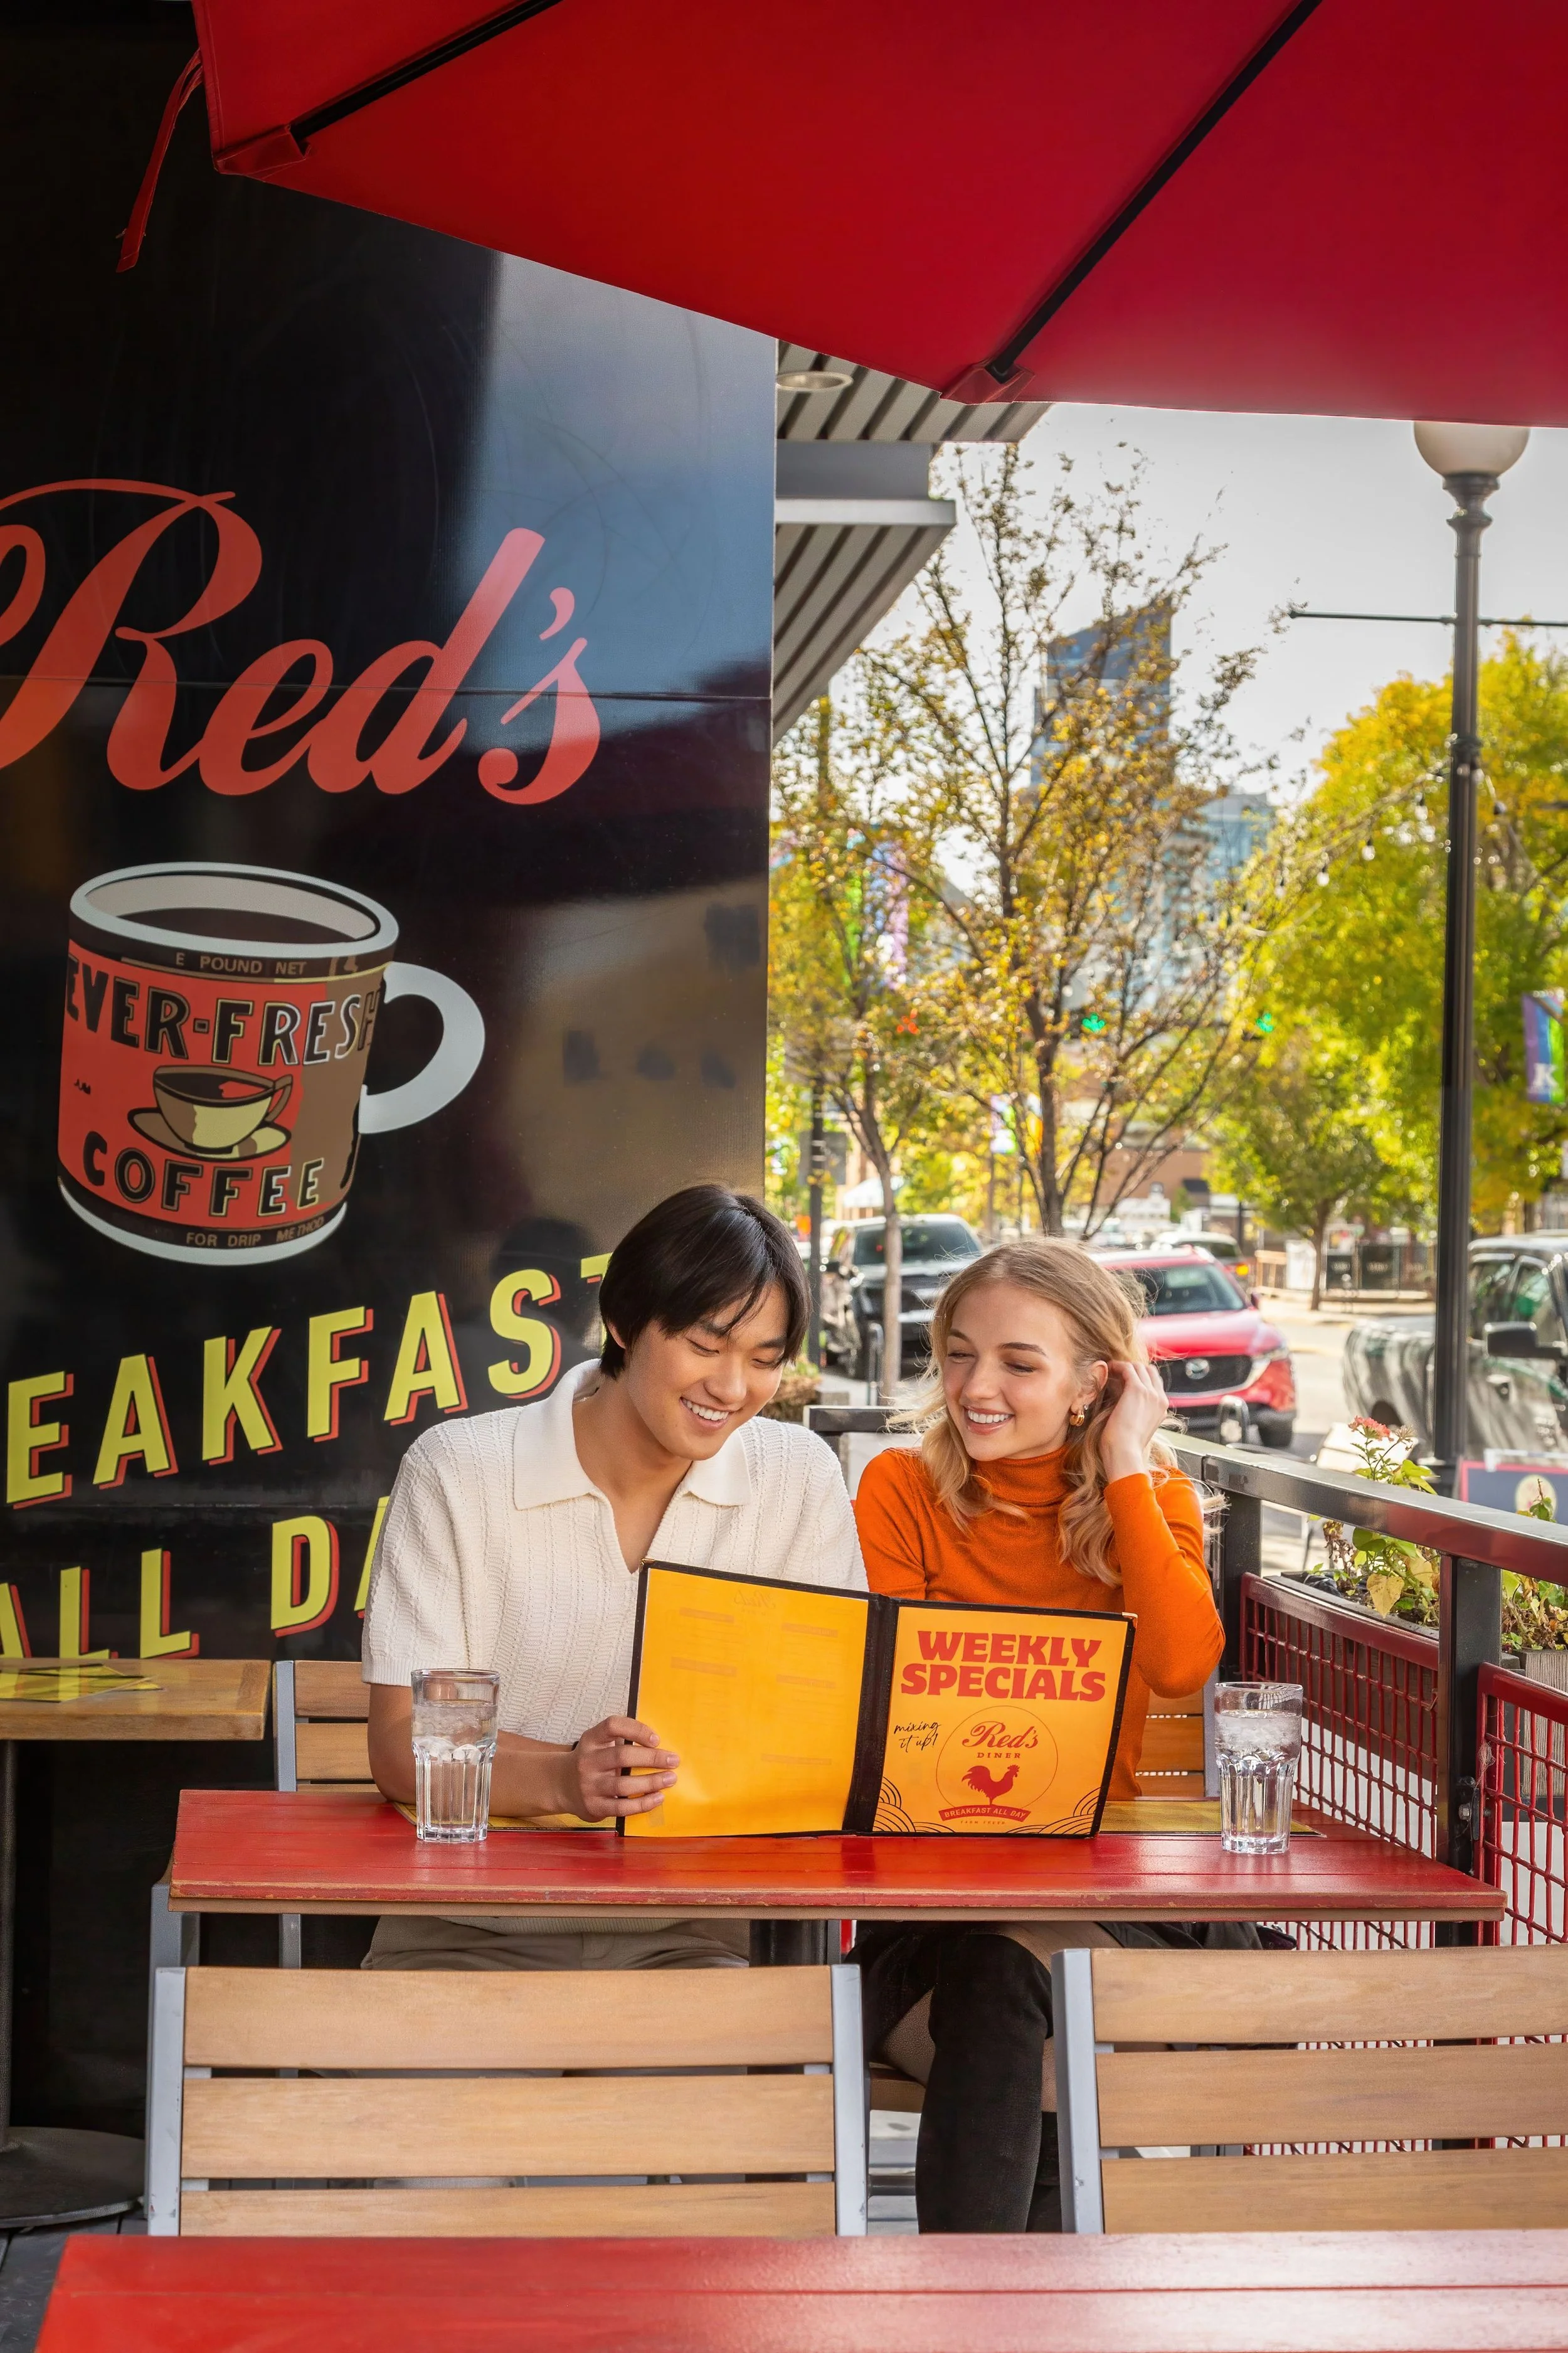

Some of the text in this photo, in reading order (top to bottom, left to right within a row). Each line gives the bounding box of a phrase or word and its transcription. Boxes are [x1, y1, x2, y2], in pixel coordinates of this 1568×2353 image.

[0, 479, 600, 805] Red's
[199, 955, 263, 974] POUND
[275, 961, 307, 975] NET
[83, 1130, 324, 1218] COFFEE
[186, 1216, 325, 1248] FOR DRIP METHOD
[918, 1630, 1102, 1668] WEEKLY
[901, 1663, 1106, 1702] SPECIALS
[894, 1721, 942, 1740] mixing
[899, 1733, 938, 1753] it up!
[962, 1721, 1039, 1749] Red's
[944, 1807, 991, 1818] BREAKFAST
[1010, 1810, 1026, 1819] DAY
